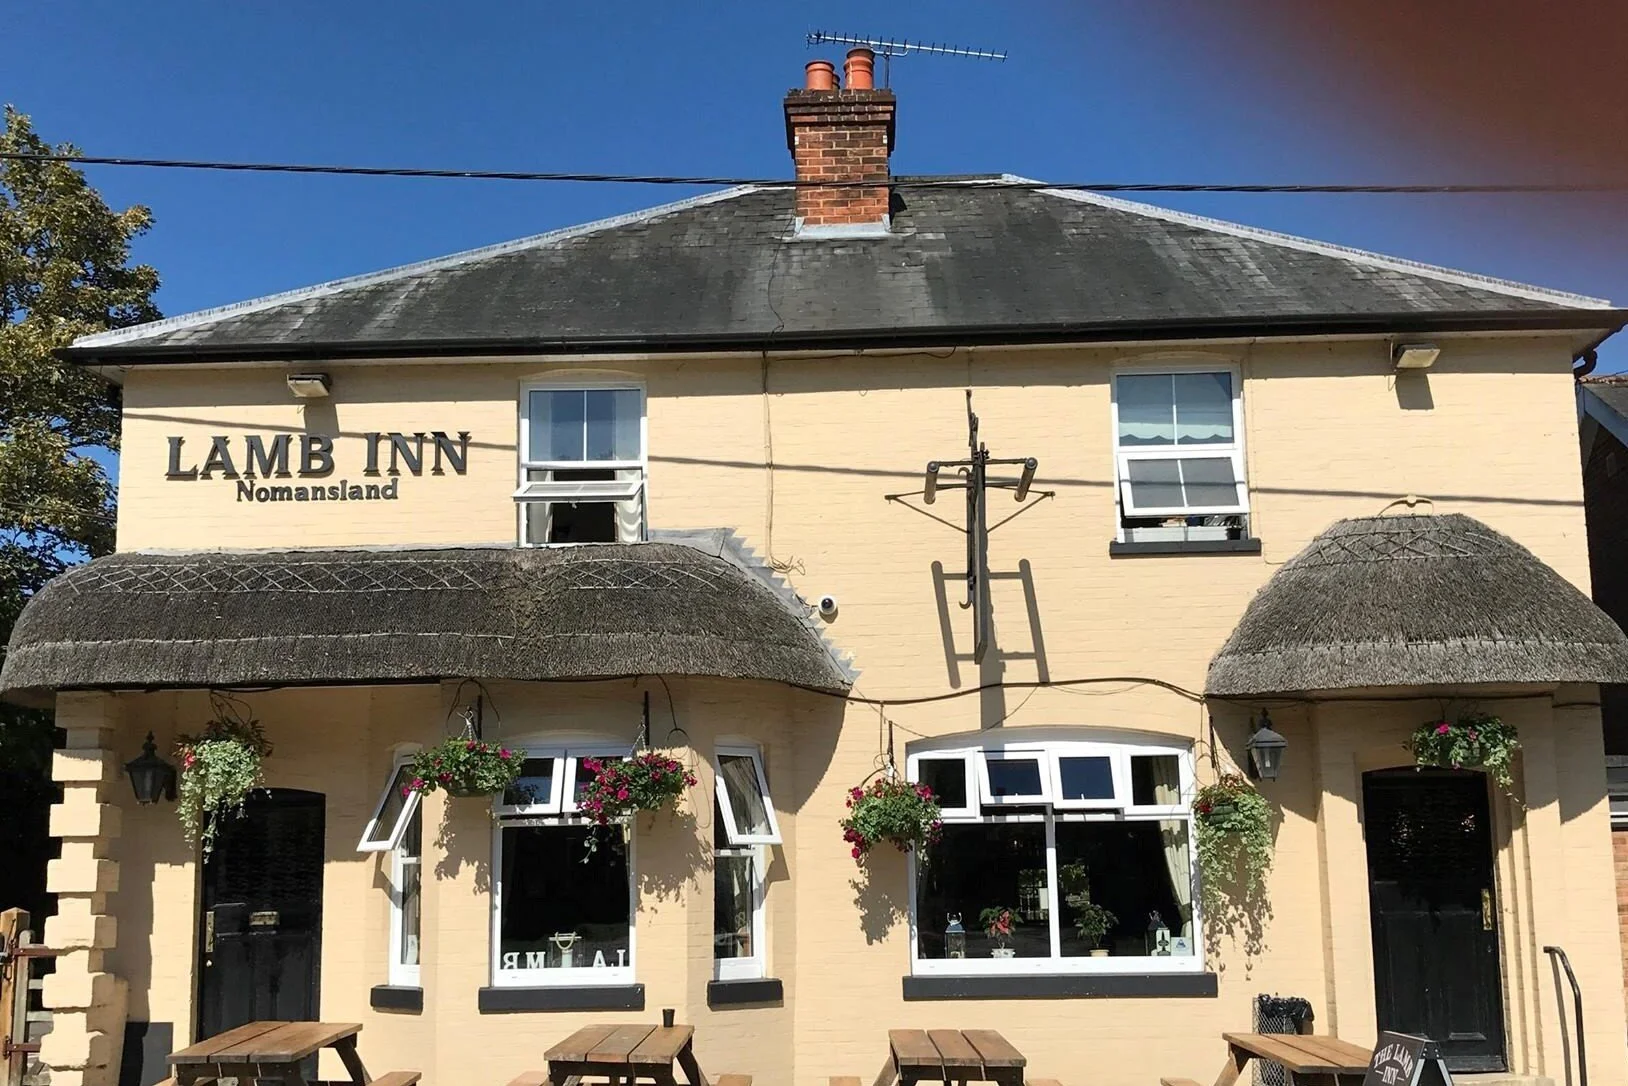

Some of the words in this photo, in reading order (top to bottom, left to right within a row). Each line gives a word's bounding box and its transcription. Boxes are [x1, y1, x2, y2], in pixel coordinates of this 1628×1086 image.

[165, 434, 335, 481] LAMB
[363, 431, 470, 476] INN
[236, 478, 399, 502] Nomansland
[1373, 1043, 1394, 1069] THE
[1393, 1043, 1414, 1079] LAMB
[1382, 1065, 1399, 1086] INN
